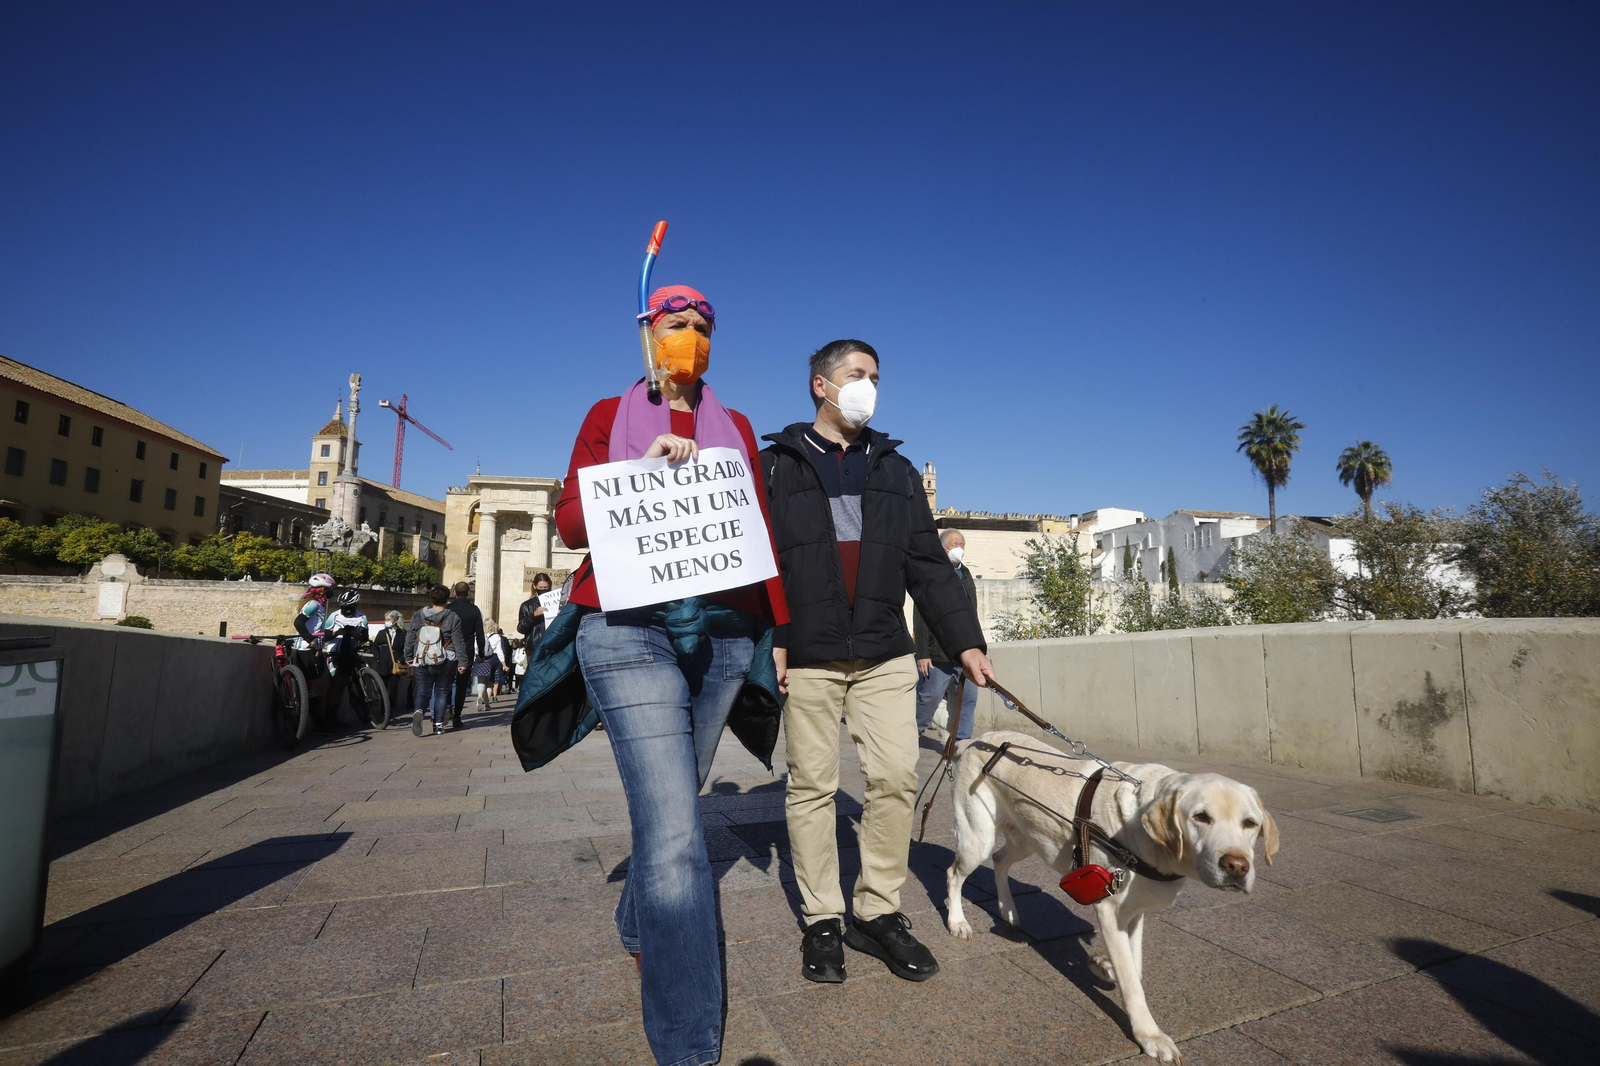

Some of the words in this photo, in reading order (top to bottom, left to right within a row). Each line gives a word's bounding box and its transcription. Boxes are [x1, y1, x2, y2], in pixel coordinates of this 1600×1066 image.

[591, 477, 623, 499] NI
[628, 470, 665, 493] UN
[673, 461, 745, 486] GRADO
[607, 499, 667, 529] MÁS
[672, 495, 702, 518] NI
[707, 488, 750, 511] UNA
[635, 519, 743, 555] ESPECIE
[649, 549, 743, 584] MENOS
